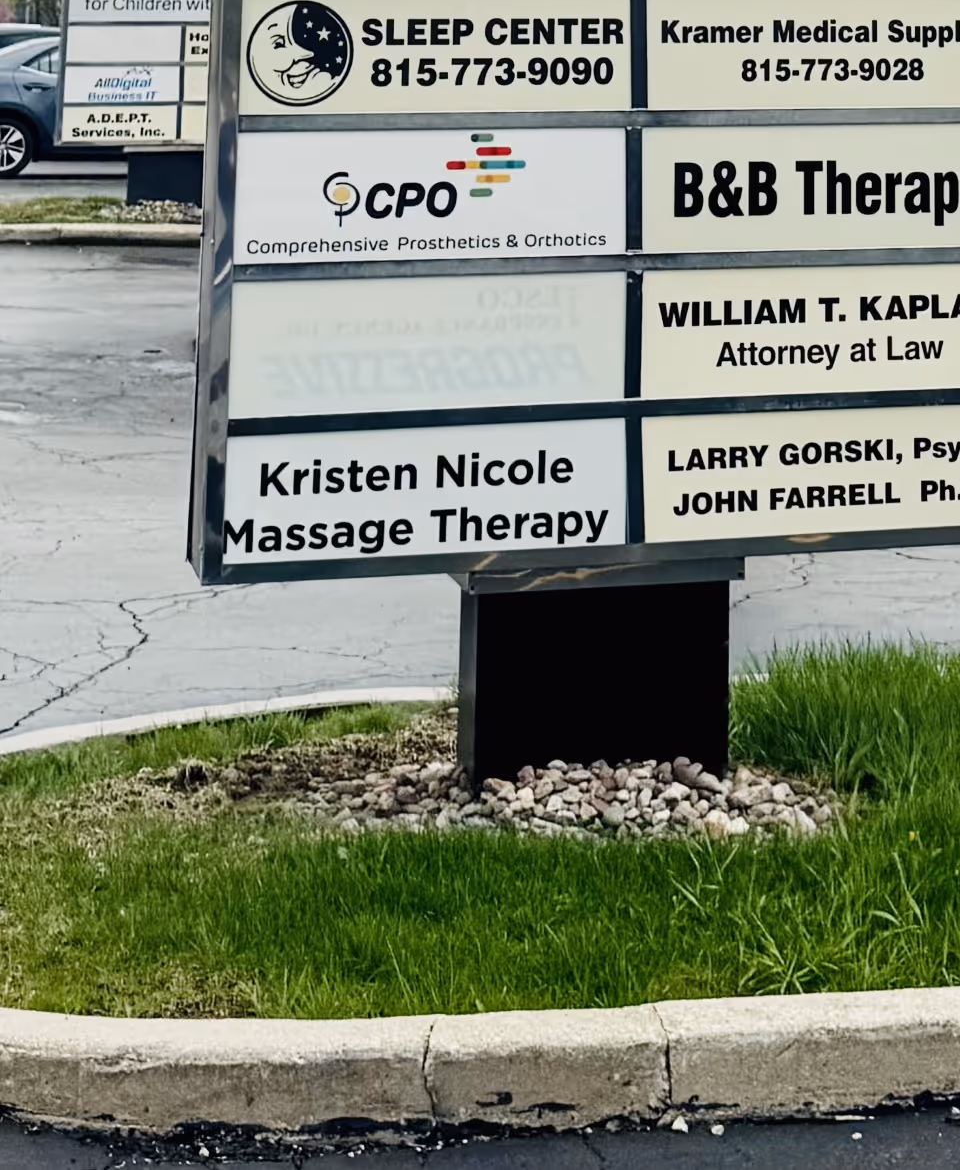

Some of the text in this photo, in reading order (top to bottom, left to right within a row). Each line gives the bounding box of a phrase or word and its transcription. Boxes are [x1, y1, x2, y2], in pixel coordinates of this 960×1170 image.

[362, 18, 623, 46] SLEEP CENTER
[662, 20, 763, 43] Kramer
[774, 20, 877, 43] Medical
[371, 57, 613, 87] 815-773-9090
[742, 58, 924, 81] 815-773-9028
[72, 128, 164, 138] Services, Inc.
[87, 114, 152, 123] A.D.E.P.T.
[365, 182, 457, 219] CPO
[674, 161, 777, 217] B&B
[247, 234, 606, 256] Comprehensive Prosthetics & Orthotics
[659, 299, 805, 327] WILLIAM
[819, 298, 846, 322] T.
[716, 336, 943, 370] Attorney at Law
[669, 445, 768, 471] LARRY
[780, 439, 902, 465] GORSKI,
[260, 450, 573, 496] Kristen Nicole
[673, 490, 757, 516] JOHN
[770, 482, 900, 510] FARRELL
[223, 507, 608, 555] Massage Therapy
